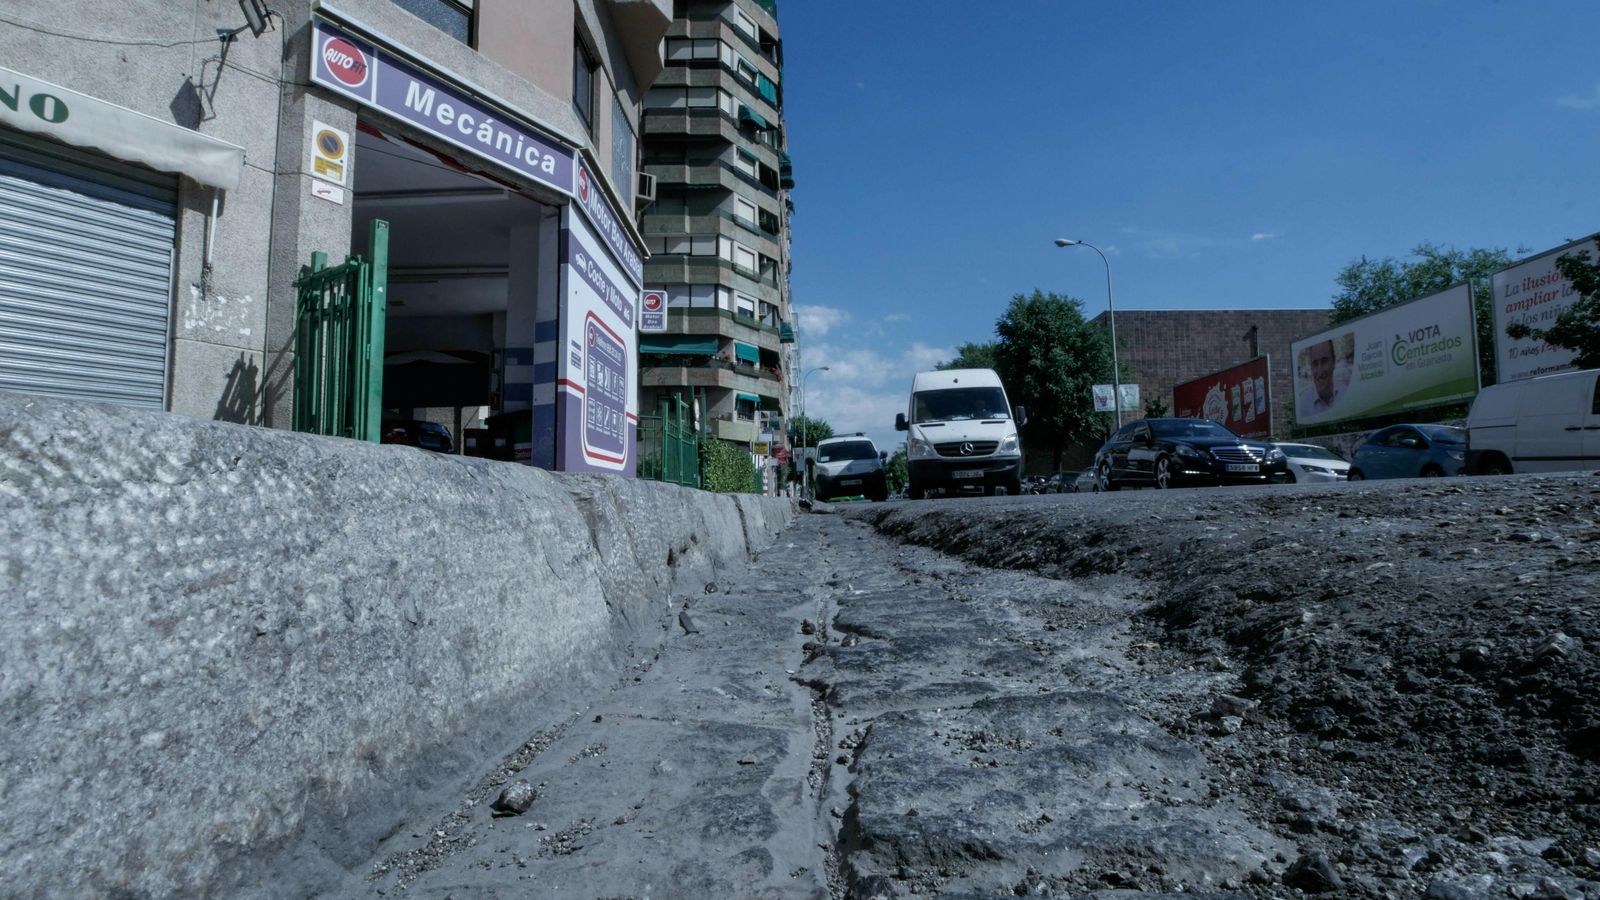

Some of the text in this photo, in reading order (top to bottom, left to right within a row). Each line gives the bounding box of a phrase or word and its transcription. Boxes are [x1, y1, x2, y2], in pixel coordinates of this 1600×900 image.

[325, 47, 368, 75] AUTOFIT
[404, 80, 556, 176] Mecánica
[590, 188, 611, 233] Motor
[611, 221, 624, 254] Box
[588, 260, 623, 312] Coche y Moto
[1504, 284, 1519, 298] La
[1505, 290, 1560, 313] ampliar
[1522, 312, 1540, 325] los
[1541, 304, 1572, 321] niño
[1408, 324, 1440, 343] VOTA
[1391, 337, 1462, 367] Centrados
